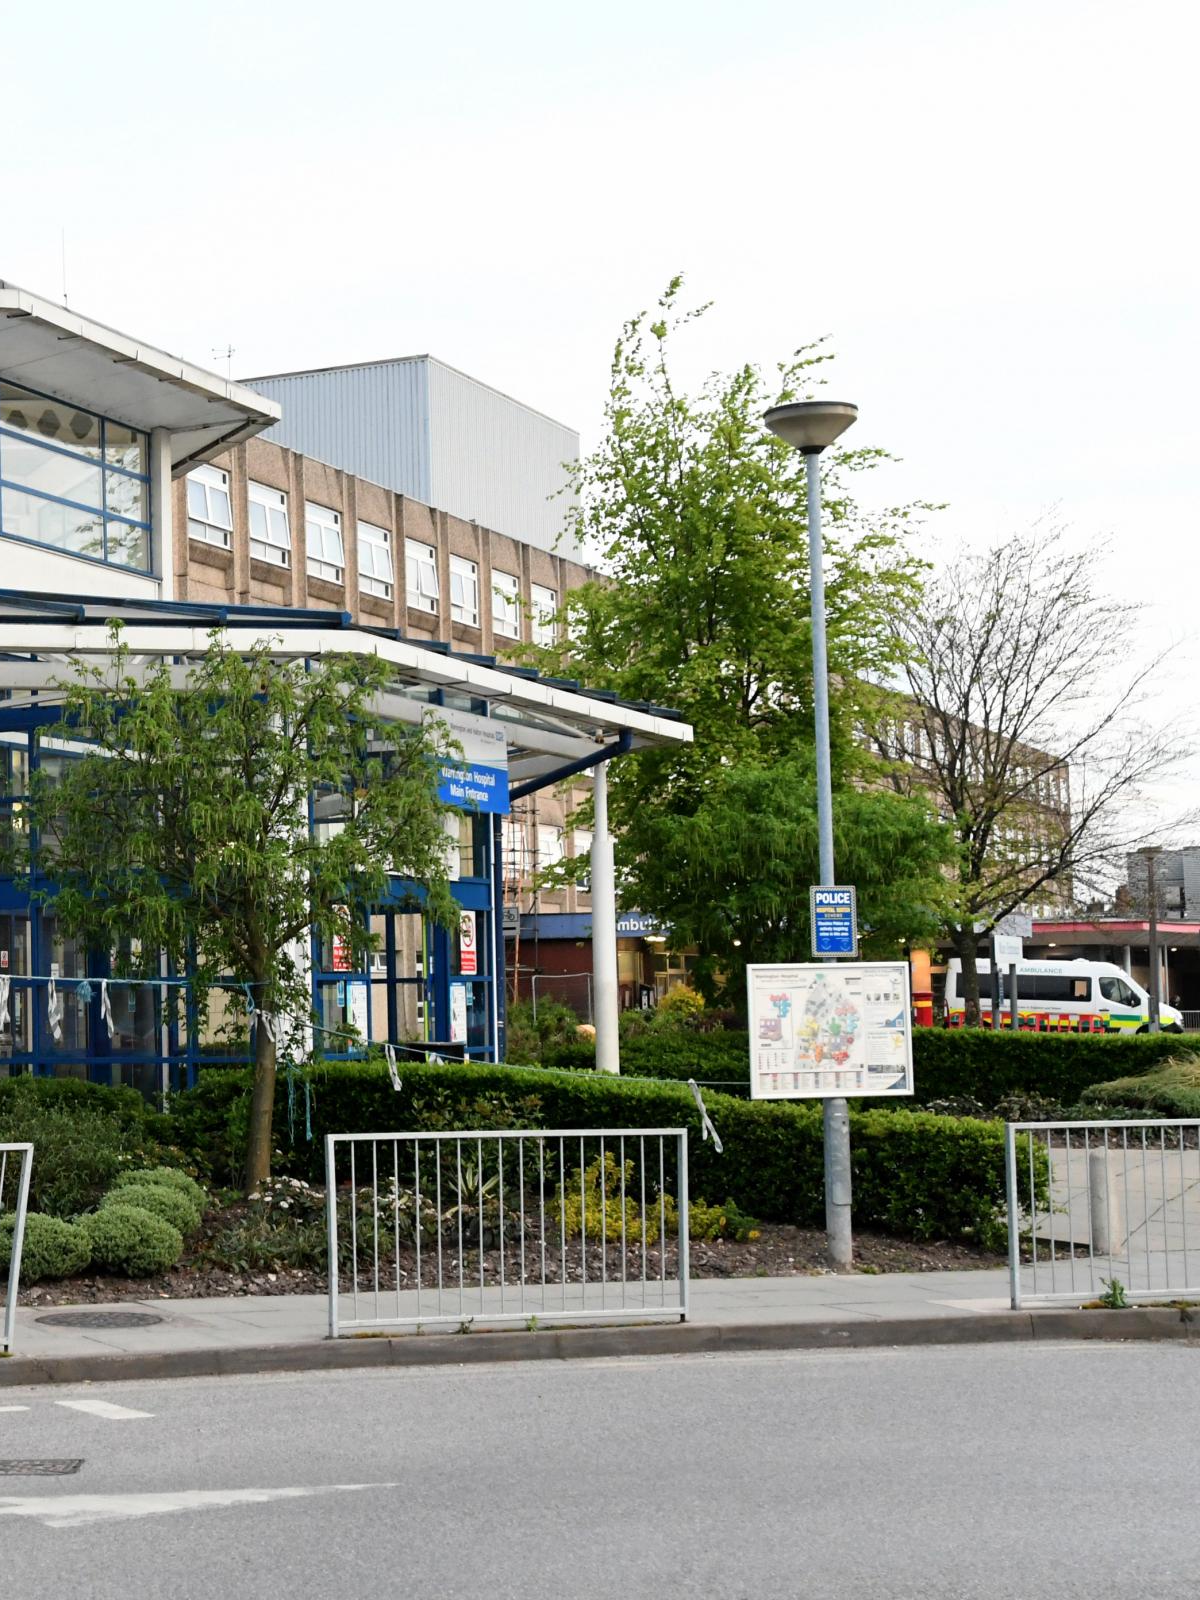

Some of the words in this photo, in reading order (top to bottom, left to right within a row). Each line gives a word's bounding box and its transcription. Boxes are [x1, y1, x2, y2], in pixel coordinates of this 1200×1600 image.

[442, 767, 473, 783] Warringon
[474, 771, 496, 787] Hospital
[450, 783, 464, 797] Main
[465, 786, 488, 801] Entrance
[816, 892, 850, 904] POLICE
